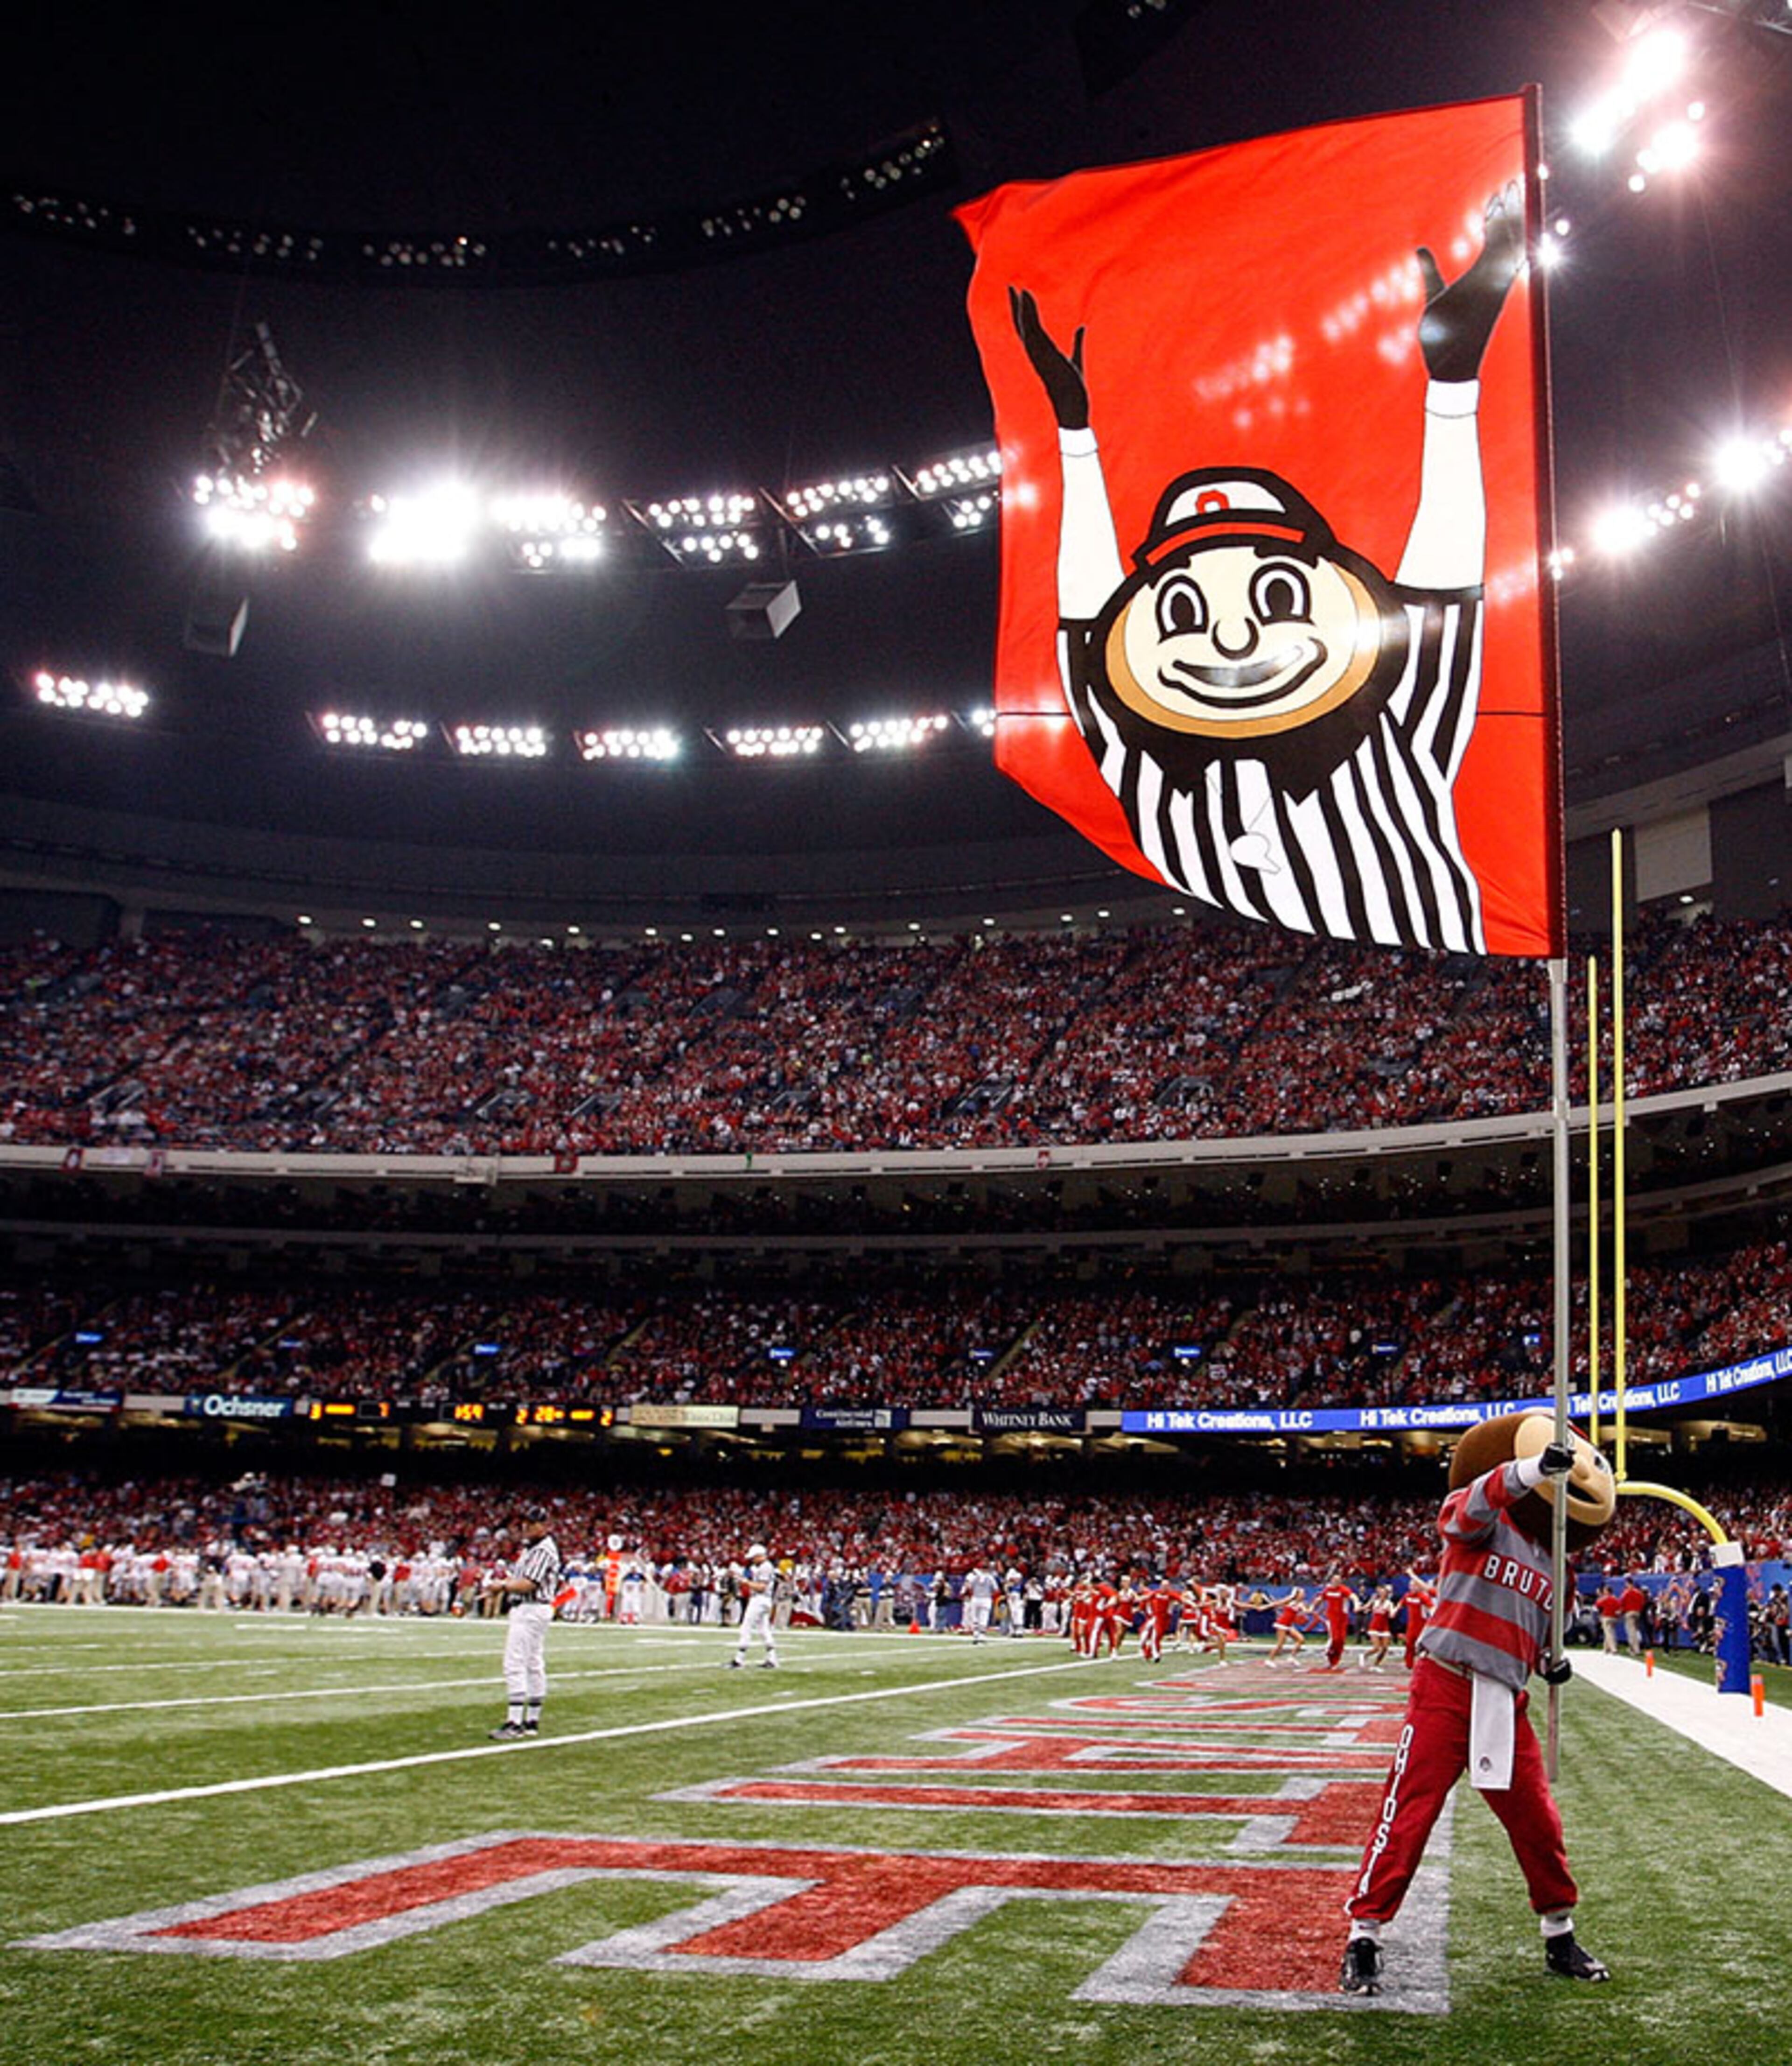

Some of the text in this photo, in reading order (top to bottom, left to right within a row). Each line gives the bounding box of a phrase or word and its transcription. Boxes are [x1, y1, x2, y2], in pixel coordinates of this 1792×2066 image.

[203, 1394, 286, 1416] Ochsner
[1598, 1388, 1656, 1410] Crtions,
[1658, 1382, 1680, 1403] LLC
[1167, 1412, 1196, 1429] Tek
[1280, 1411, 1313, 1428] LLC
[1379, 1408, 1408, 1426] Tek
